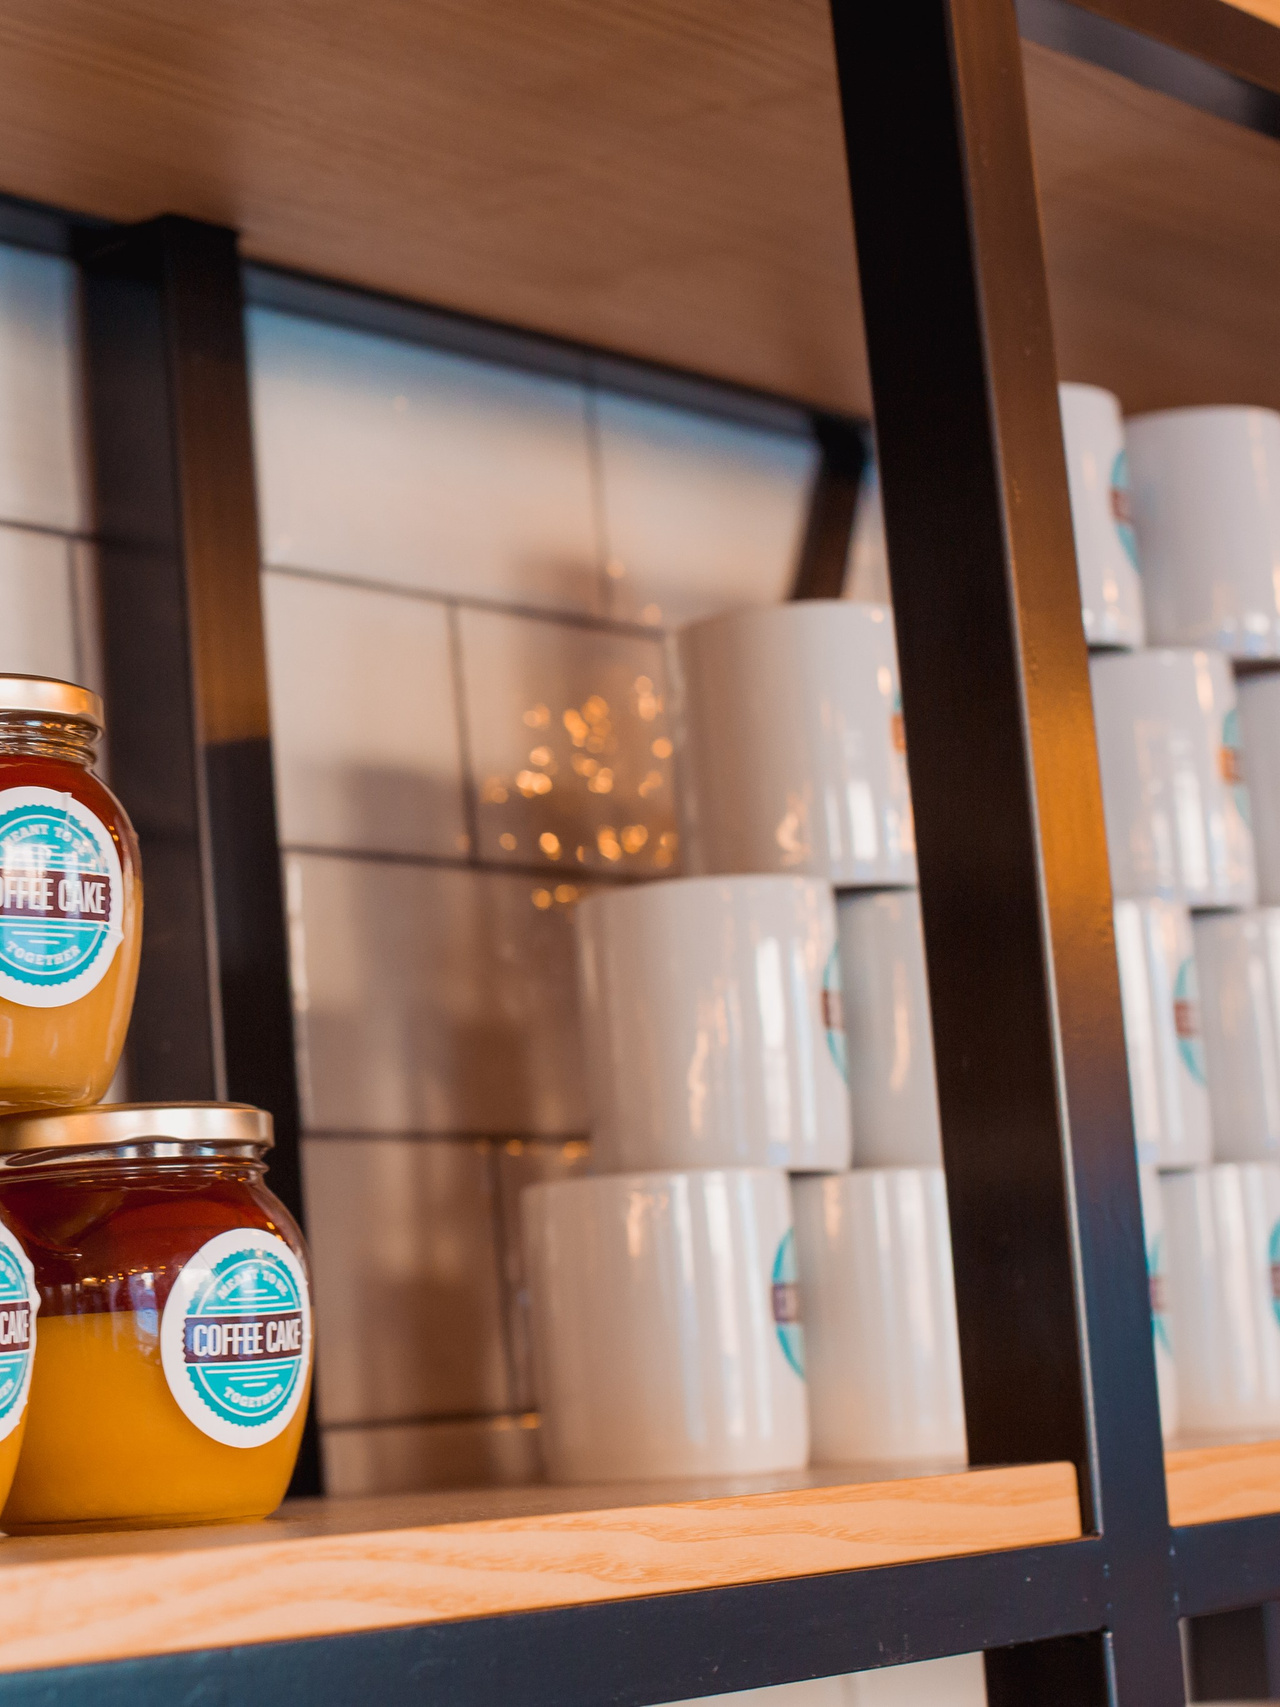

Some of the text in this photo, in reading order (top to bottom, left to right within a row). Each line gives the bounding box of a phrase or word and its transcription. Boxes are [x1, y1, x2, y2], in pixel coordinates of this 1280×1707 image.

[54, 826, 71, 843] TO
[58, 880, 106, 914] CAKE
[5, 940, 81, 967] TOGETHER
[217, 1268, 259, 1300] MEANT
[262, 1270, 277, 1286] TO
[193, 1318, 302, 1357] COFFEE CAKE
[223, 1383, 284, 1408] TOGETHER
